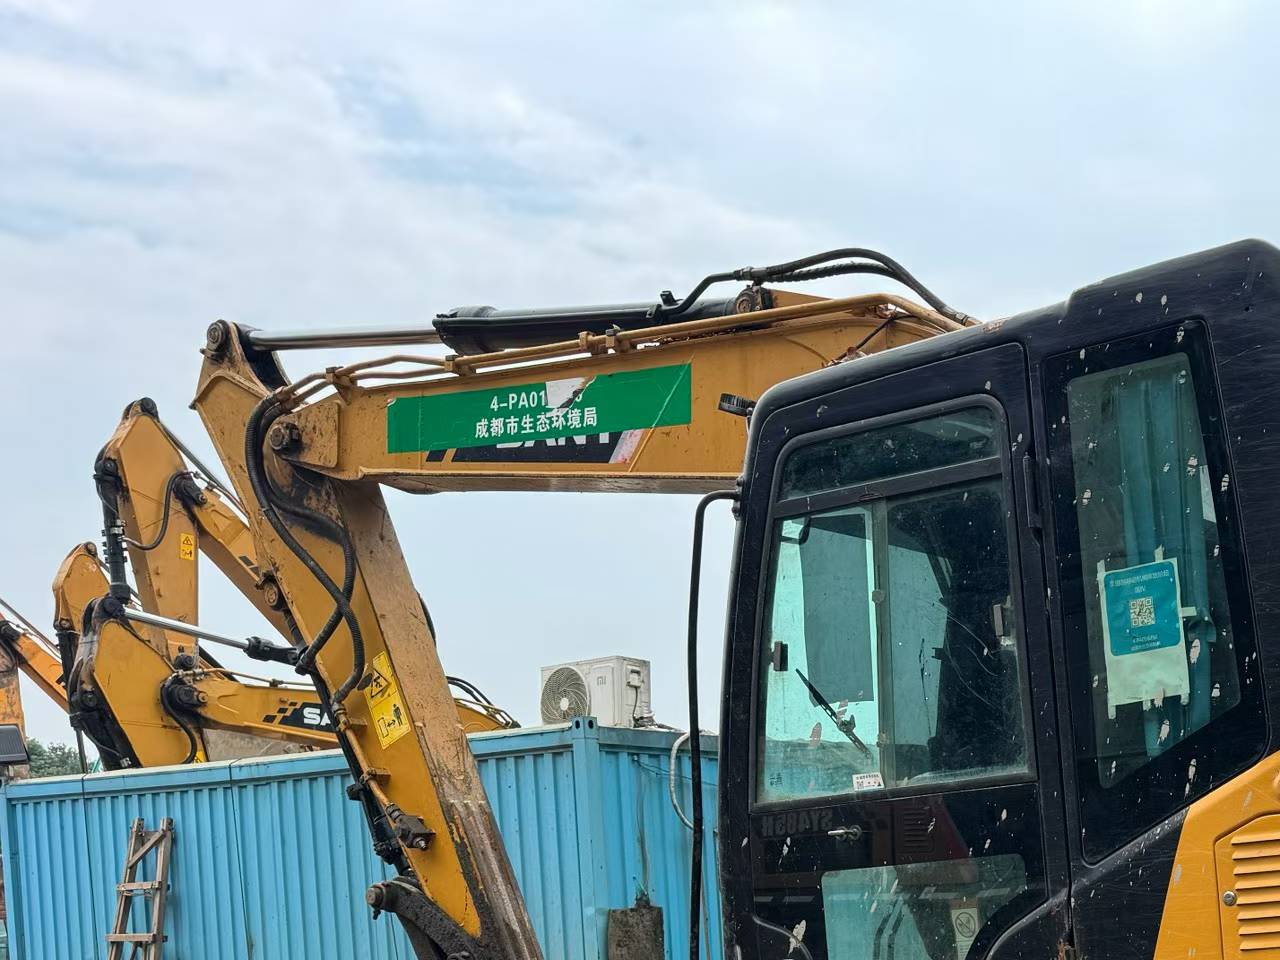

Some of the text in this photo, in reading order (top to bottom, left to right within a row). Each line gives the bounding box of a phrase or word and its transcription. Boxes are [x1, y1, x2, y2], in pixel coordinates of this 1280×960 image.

[475, 407, 597, 438] 成都市生态环境局
